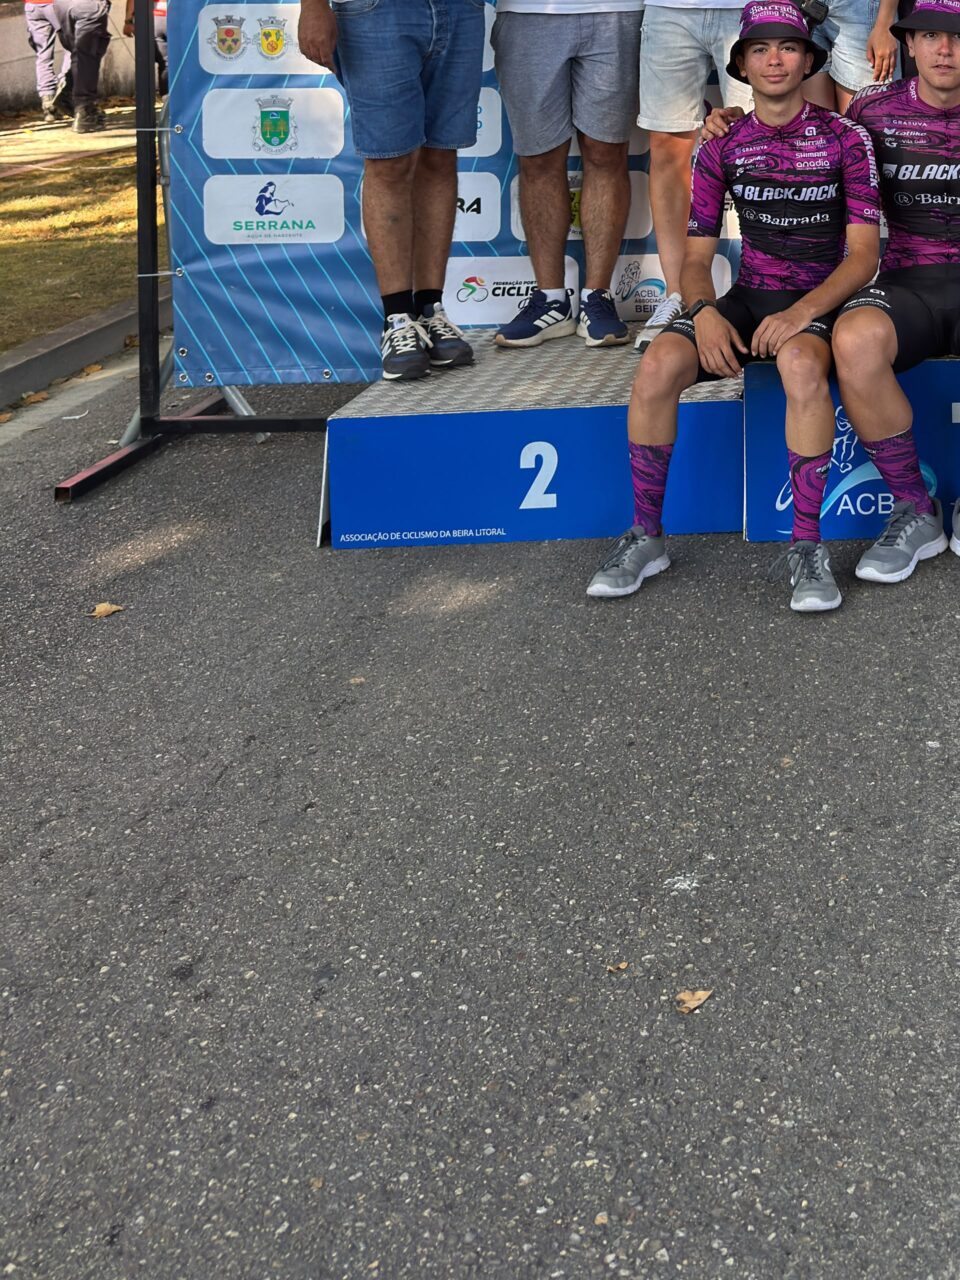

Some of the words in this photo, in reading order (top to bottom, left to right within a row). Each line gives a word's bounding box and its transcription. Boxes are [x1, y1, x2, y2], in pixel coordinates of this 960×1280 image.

[796, 159, 830, 169] anadia
[744, 182, 839, 201] BLACKJACK
[232, 219, 317, 231] SERRANA
[758, 212, 831, 227] Bairrada
[634, 289, 659, 298] ACBL
[519, 440, 559, 510] 2
[836, 493, 895, 516] ACB
[340, 532, 389, 543] ASSOCIAÇÃO
[390, 532, 401, 540] DE
[402, 530, 439, 540] CICLISMO
[439, 530, 451, 538] DA
[452, 529, 474, 537] BEIRA
[475, 528, 507, 537] LITORAL
